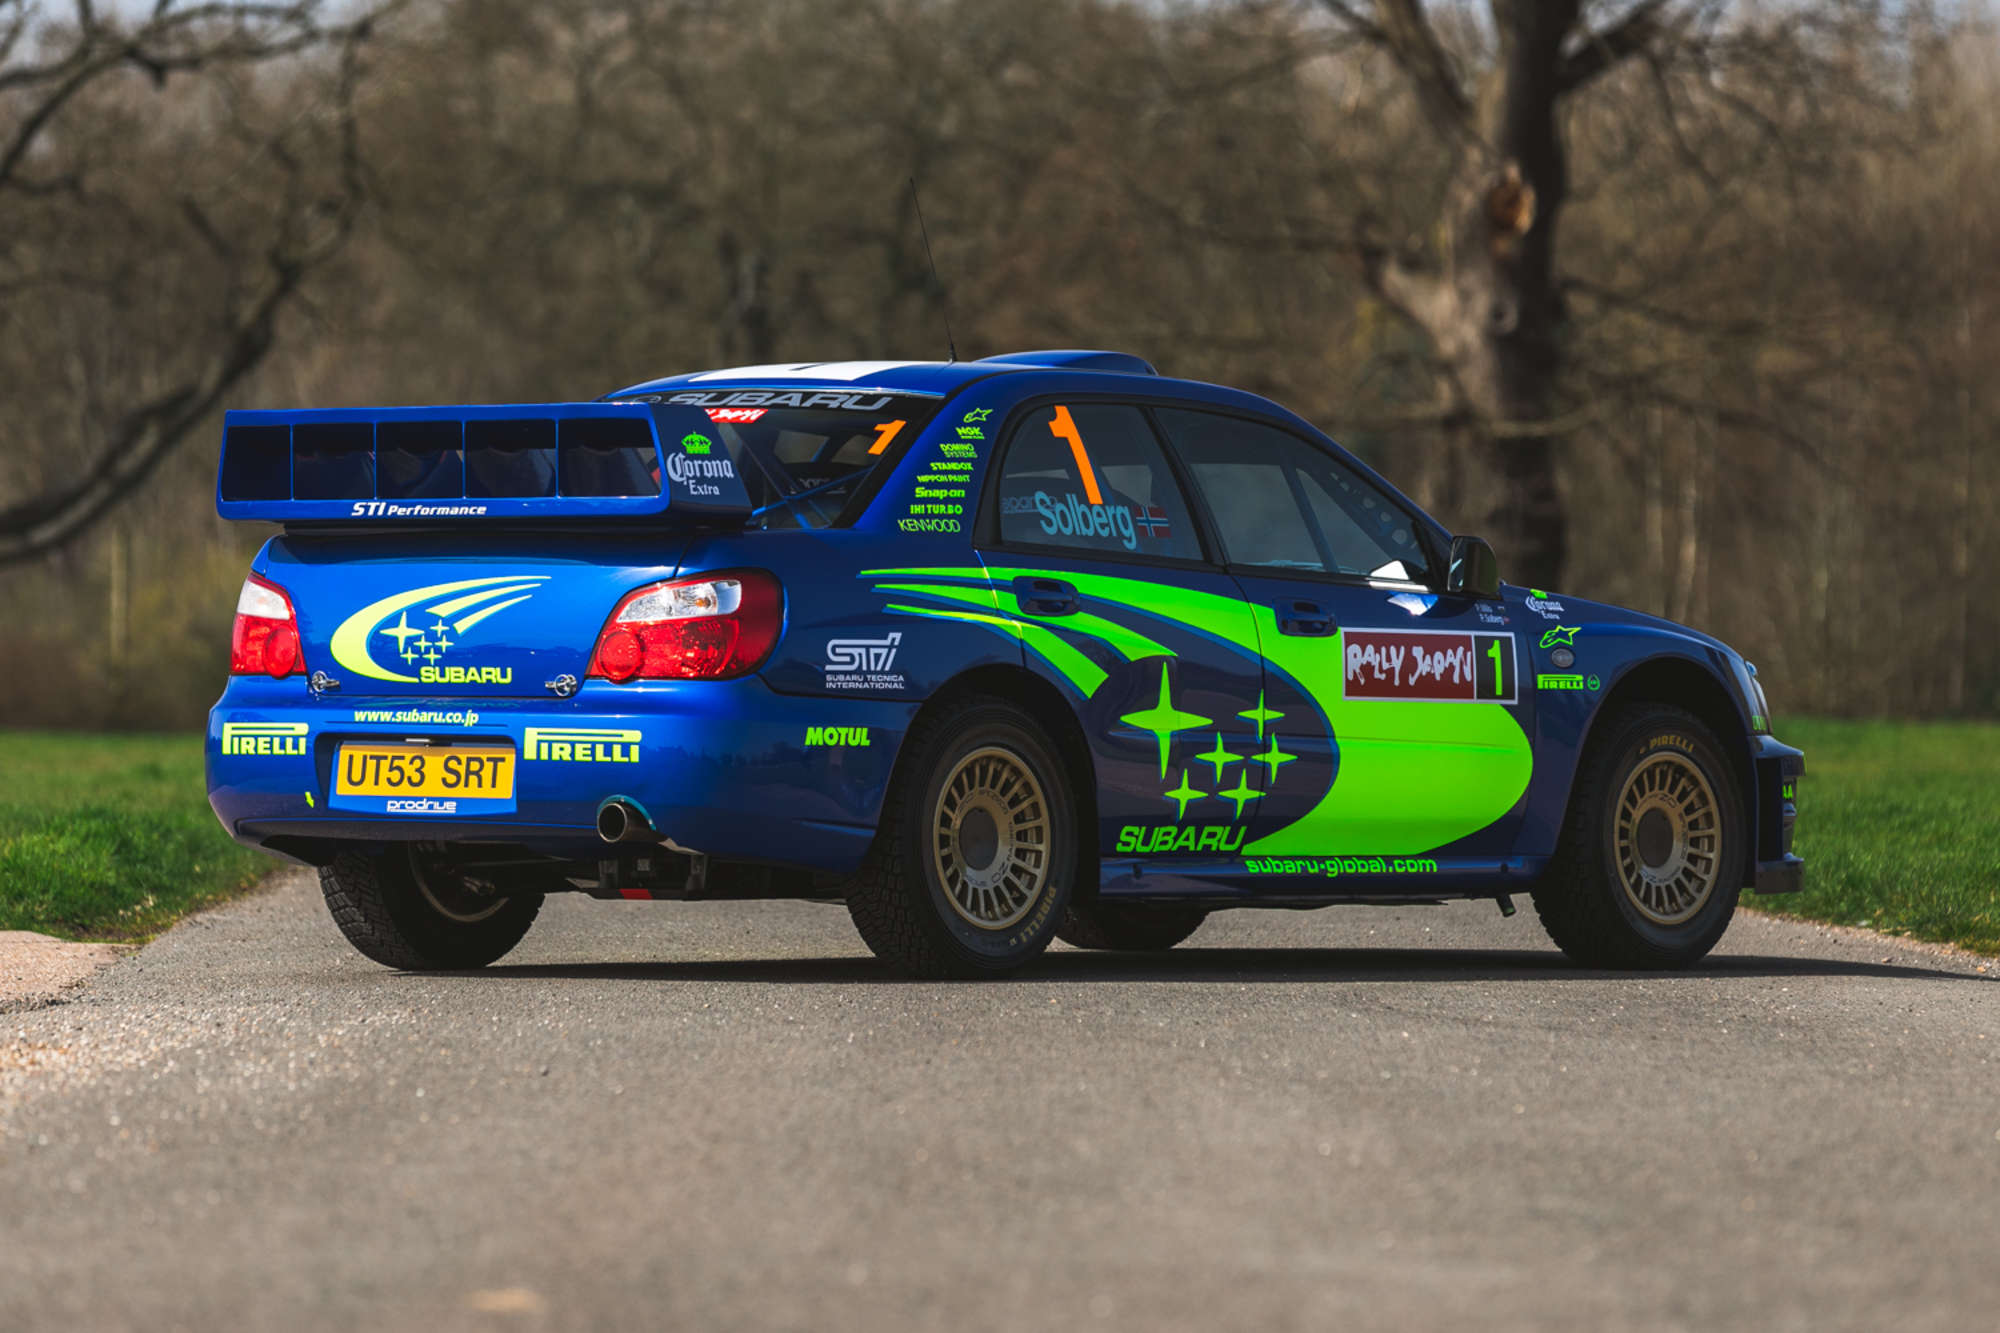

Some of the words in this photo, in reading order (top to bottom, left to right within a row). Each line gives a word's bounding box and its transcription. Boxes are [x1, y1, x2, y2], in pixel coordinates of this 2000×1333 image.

[667, 392, 893, 411] SUBARU
[867, 419, 907, 456] 1
[1048, 405, 1103, 505] 1
[666, 452, 735, 485] Corona
[689, 479, 720, 496] Extra
[351, 502, 386, 517] STI
[387, 504, 487, 516] Performance
[926, 503, 963, 515] TURBO
[897, 519, 961, 532] KENWOOD
[1034, 491, 1137, 550] Solberg
[1347, 643, 1405, 686] RALLY
[1408, 646, 1472, 686] JAPAN
[1487, 639, 1503, 696] 1
[419, 666, 512, 684] SUBARU
[825, 674, 865, 682] SUBARU
[866, 674, 905, 682] TECNICA
[1537, 674, 1584, 690] PIRELLI
[354, 709, 479, 727] www.subaru.co.jp
[222, 722, 309, 755] PIRELLI
[524, 727, 642, 763] PIRELLI
[804, 727, 871, 746] MOTUL
[1650, 735, 1694, 753] PIRELLI
[346, 755, 427, 788] UT53
[440, 756, 507, 789] SRT
[386, 799, 458, 814] prodrive
[1116, 826, 1248, 853] SUBARU
